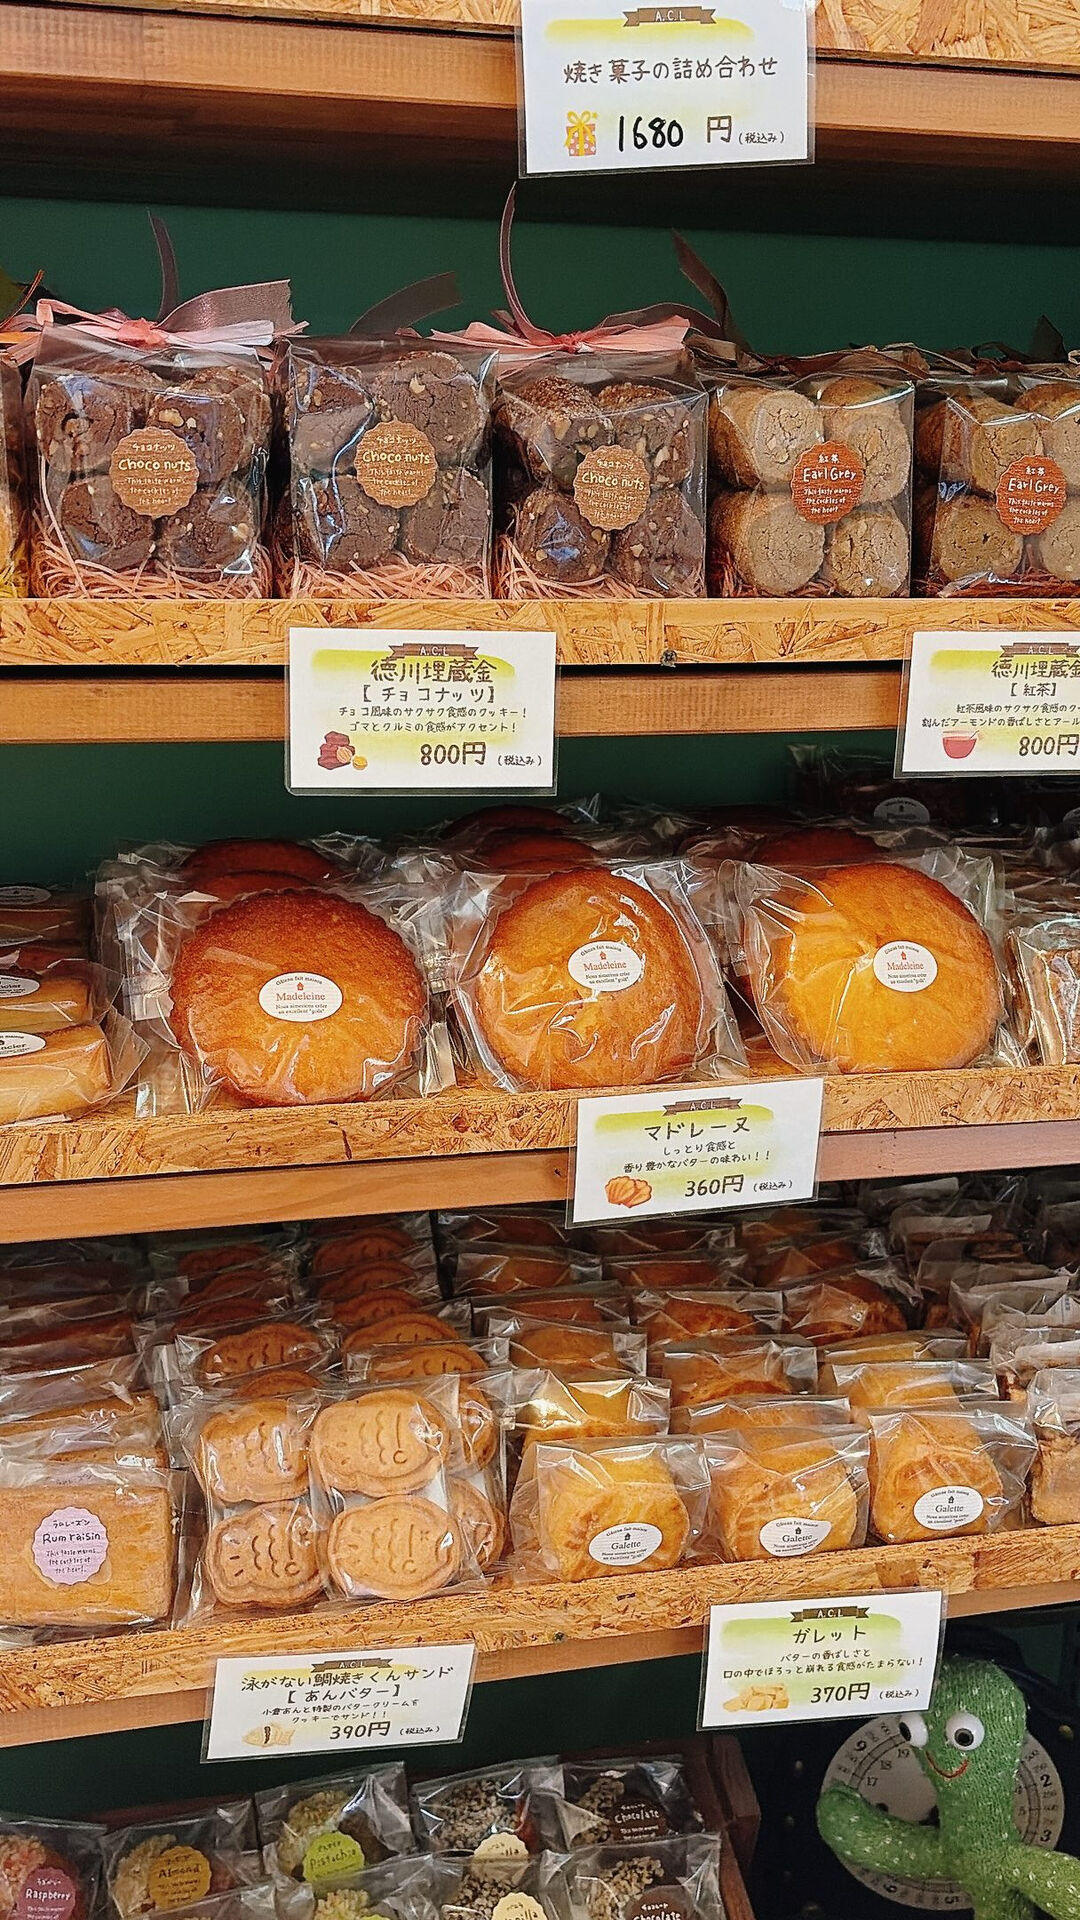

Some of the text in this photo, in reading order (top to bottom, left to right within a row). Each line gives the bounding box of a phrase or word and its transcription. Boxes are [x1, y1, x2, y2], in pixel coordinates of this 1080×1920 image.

[656, 10, 686, 22] A.C.L
[563, 55, 779, 84] 焼き菓子の詰め合わせ
[618, 116, 684, 152] 1680
[707, 115, 732, 143] 円
[164, 459, 192, 472] nuts
[405, 452, 430, 464] nuts
[803, 467, 857, 482] Earl Grey
[621, 477, 645, 490] nuts
[1008, 478, 1060, 494] Earl Grey
[371, 656, 497, 683] 徳川埋蔵金
[956, 703, 1080, 713] 紅茶風味のサクサク食感のク
[1019, 734, 1080, 756] 800円
[420, 741, 487, 765] 800円
[583, 961, 627, 971] Madeleine
[276, 992, 326, 1001] Madeleine
[644, 1116, 751, 1142] マドレーヌ
[663, 1140, 736, 1156] しっとり食感と
[685, 1174, 744, 1197] 360円
[42, 1532, 101, 1545] Rum raisin
[793, 1624, 866, 1644] ガレット
[780, 1649, 871, 1663] バターの香ばしさと
[241, 1666, 454, 1692] 泳がない鯛焼きくんサンド
[811, 1682, 870, 1703] 370円
[329, 1721, 391, 1740] 390円
[1040, 1774, 1052, 1787] 2
[615, 1809, 660, 1824] Chocolate
[25, 1888, 71, 1902] Raspberry
